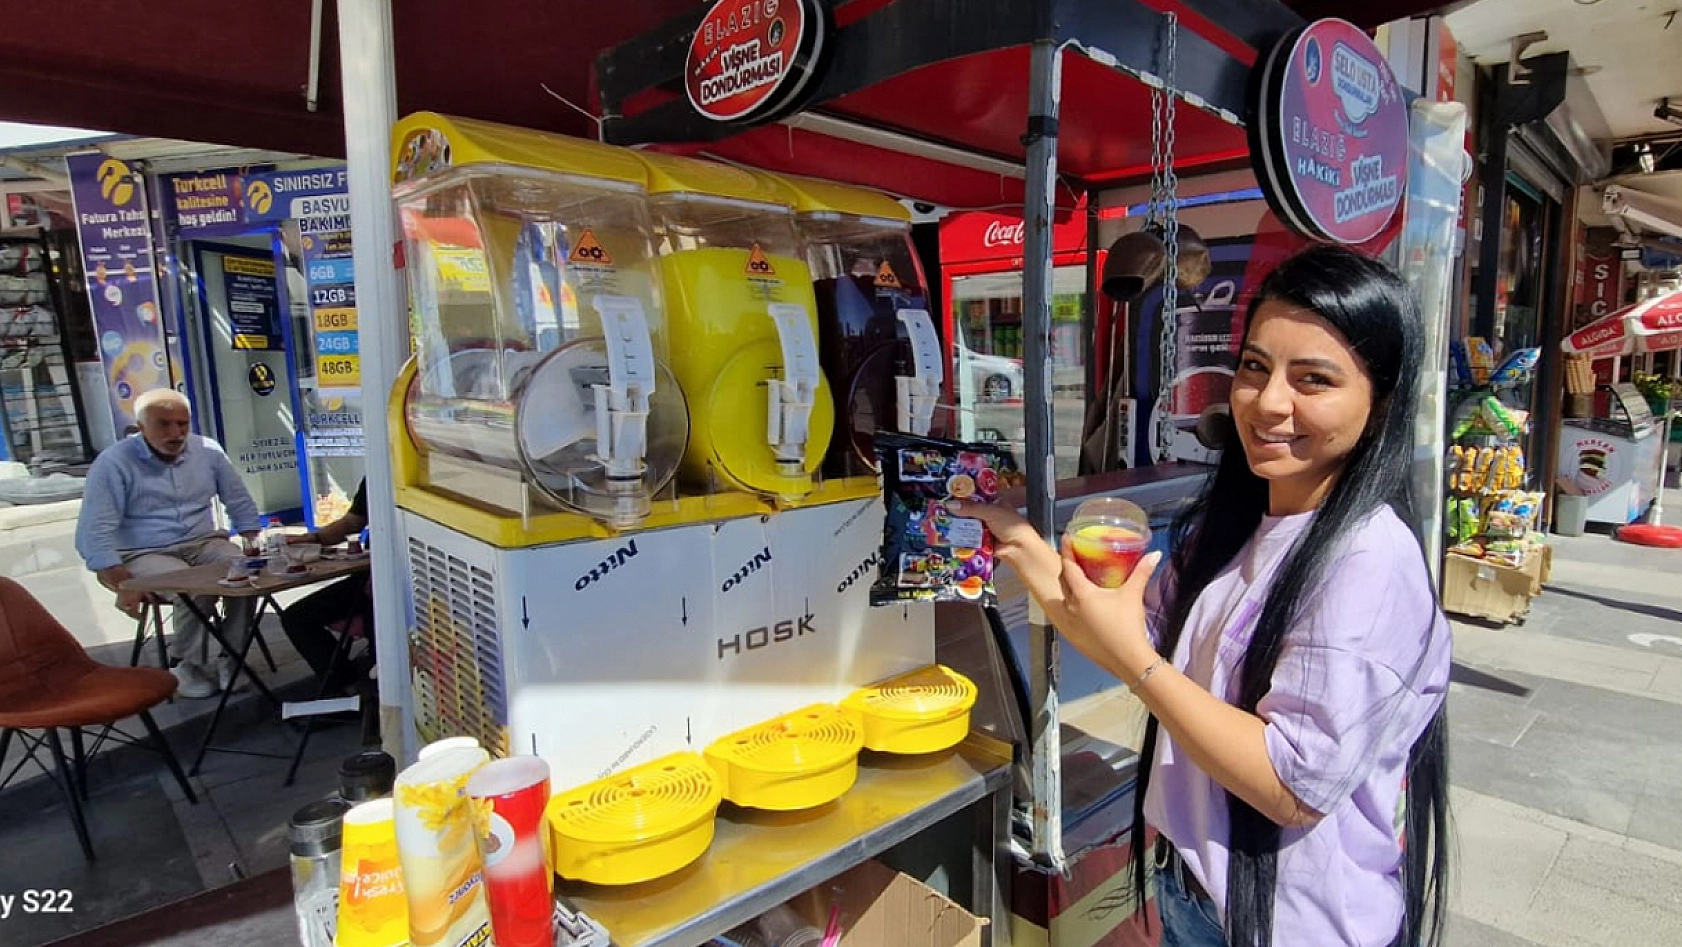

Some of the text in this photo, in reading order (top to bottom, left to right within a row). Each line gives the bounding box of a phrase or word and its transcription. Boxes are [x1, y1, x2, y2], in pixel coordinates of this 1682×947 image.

[703, 55, 781, 101] DONDURMASI
[274, 173, 334, 193] SINIRSIZ
[176, 194, 229, 210] kalitesine
[82, 213, 119, 225] Fatura
[199, 208, 238, 227] geldin!
[310, 265, 335, 280] 6GB
[314, 290, 347, 304] 12GB
[317, 314, 348, 328] 18GB
[318, 337, 351, 351] 24GB
[1581, 326, 1616, 346] ALGIDA
[321, 361, 353, 375] 48GB
[574, 538, 639, 593] Nitto
[721, 546, 773, 593] Nitto
[836, 551, 881, 594] Nitto
[717, 613, 817, 660] HOSK
